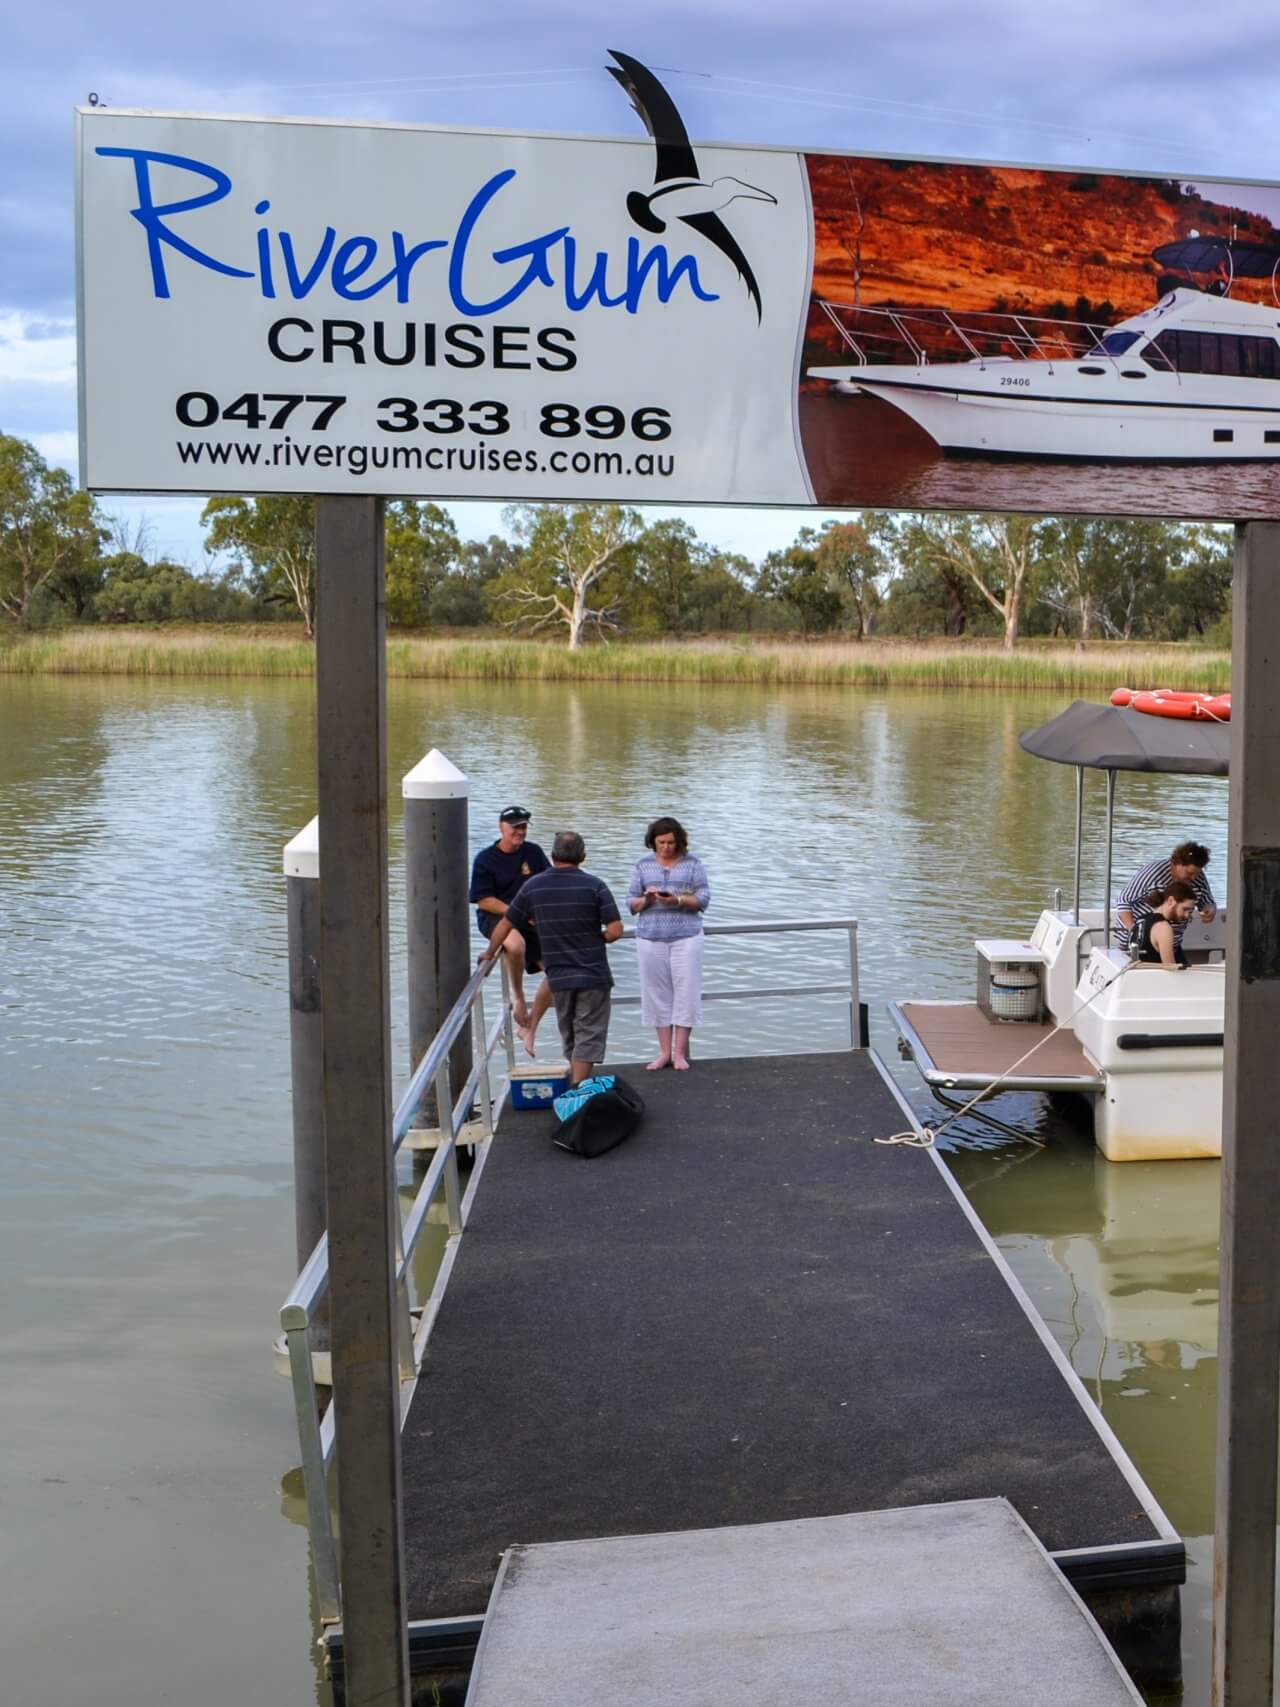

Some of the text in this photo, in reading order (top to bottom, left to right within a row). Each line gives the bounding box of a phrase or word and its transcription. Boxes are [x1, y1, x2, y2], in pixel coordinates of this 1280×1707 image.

[95, 146, 720, 316] RiverGum
[267, 318, 578, 371] CRUISES
[175, 391, 672, 442] 0477 333 896
[176, 436, 675, 476] www.rivergumcruises.com.au
